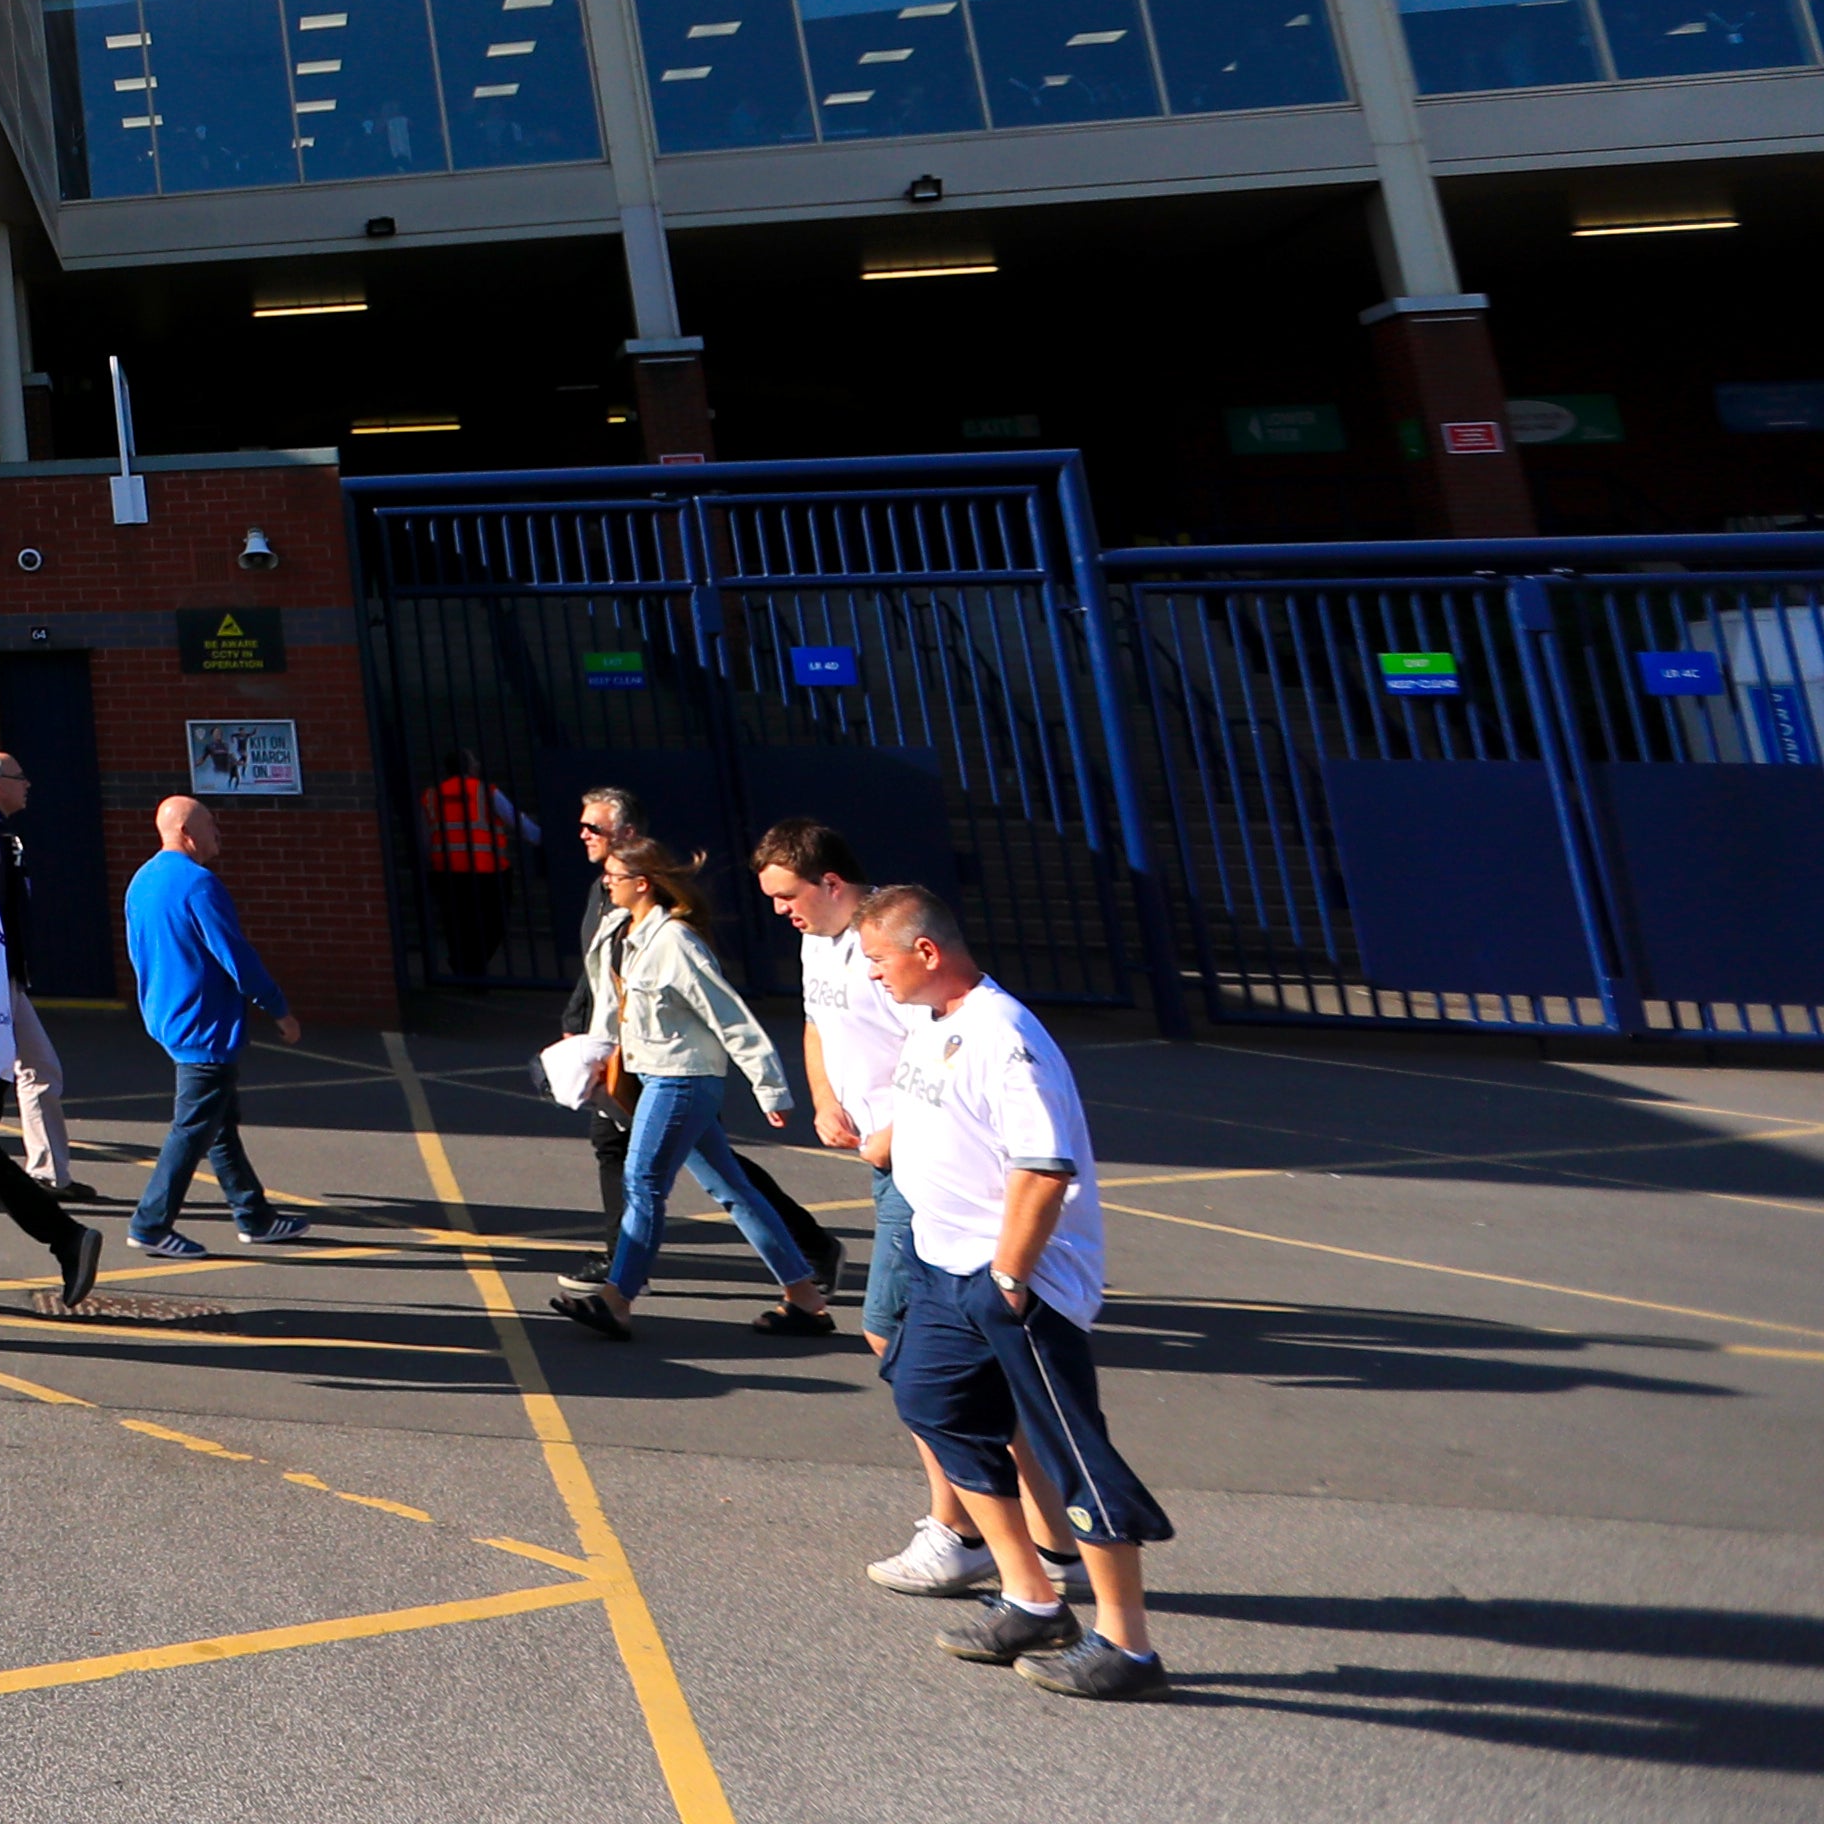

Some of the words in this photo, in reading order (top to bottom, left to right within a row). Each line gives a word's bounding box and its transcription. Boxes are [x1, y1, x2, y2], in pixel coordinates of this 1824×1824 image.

[32, 629, 47, 640] 64
[203, 639, 218, 649] BE
[221, 639, 258, 649] AWARE
[211, 649, 240, 659] CCTV
[202, 659, 264, 670] OPERATION
[249, 736, 266, 749] KIT
[251, 750, 291, 763] MARCH
[253, 765, 268, 778] ON
[808, 978, 850, 1010] 2Red
[893, 1060, 945, 1108] 2Red
